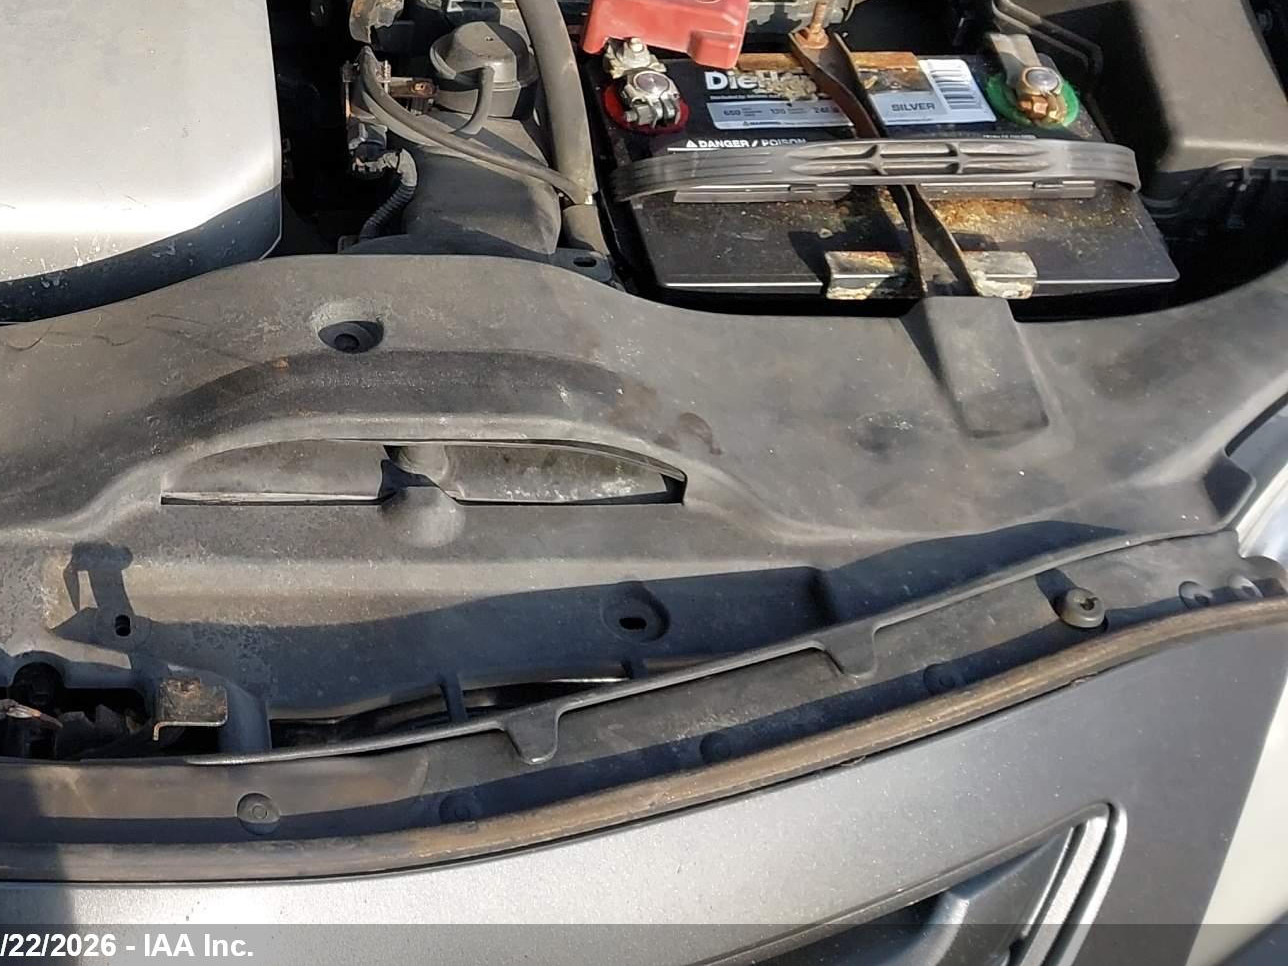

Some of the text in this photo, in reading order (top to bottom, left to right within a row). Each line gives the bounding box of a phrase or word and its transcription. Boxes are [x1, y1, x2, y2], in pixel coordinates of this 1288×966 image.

[704, 70, 790, 90] DieH
[891, 102, 935, 112] SILVER
[698, 139, 750, 148] DANGER
